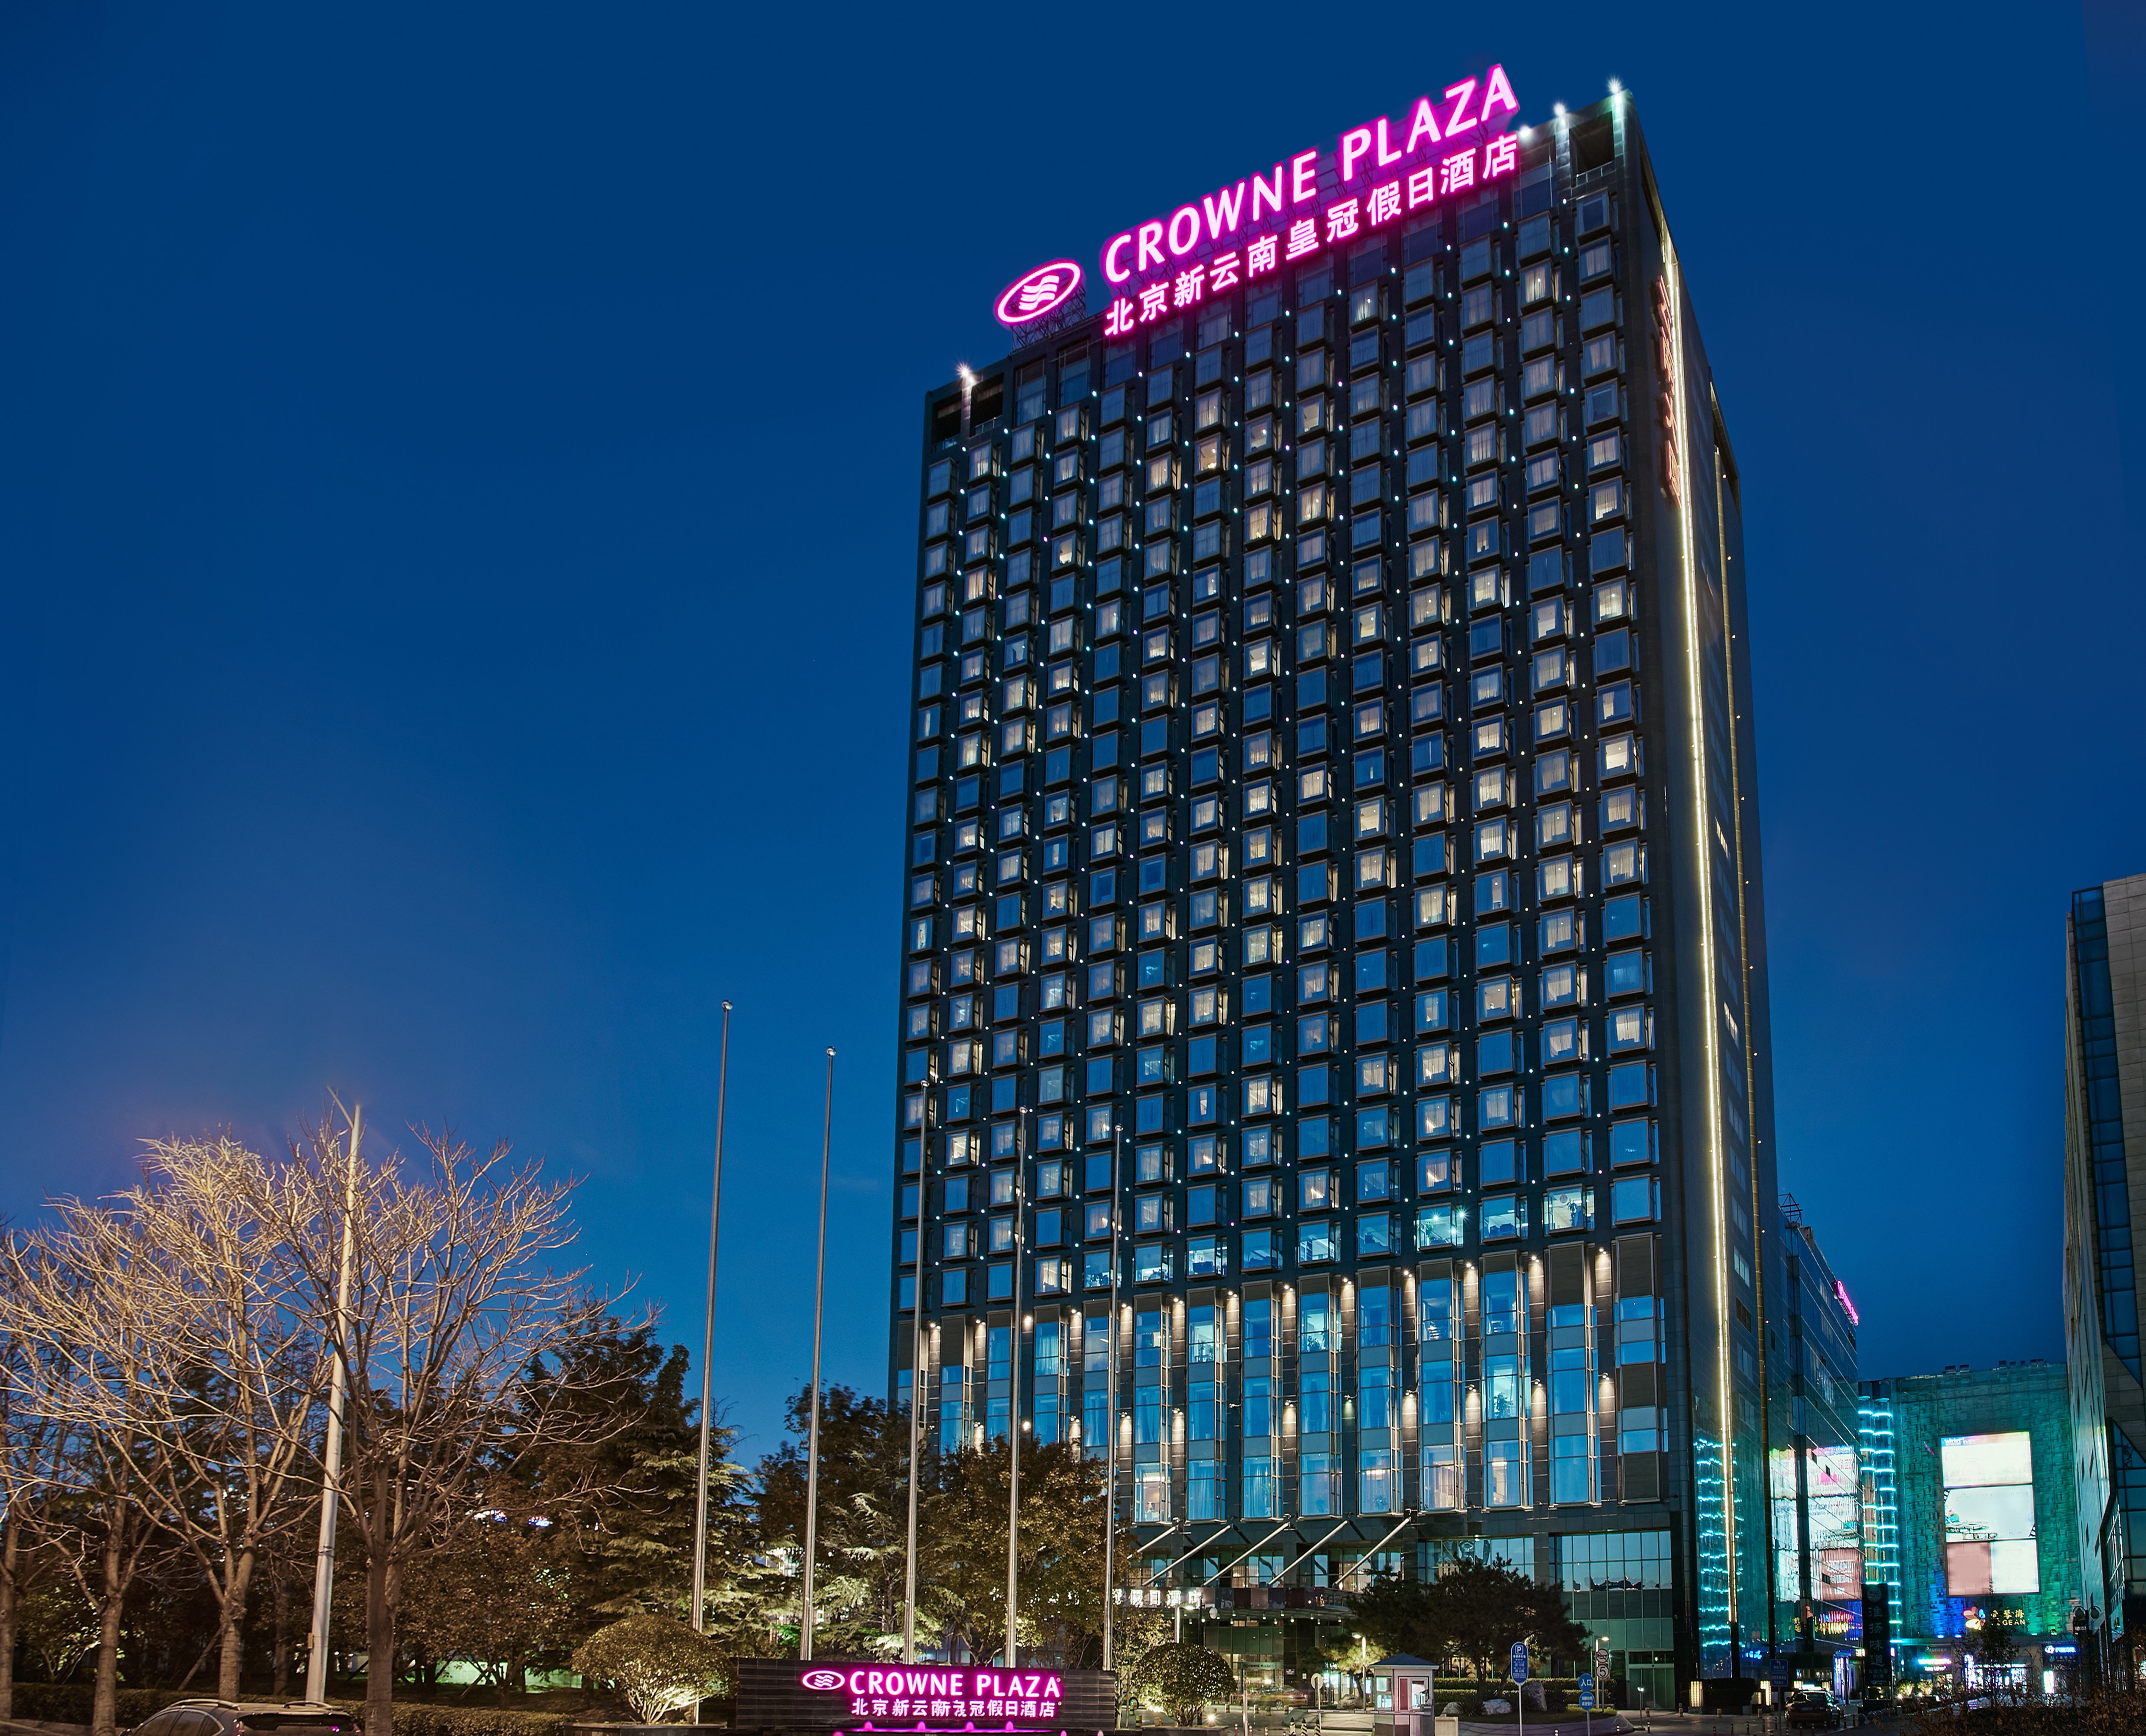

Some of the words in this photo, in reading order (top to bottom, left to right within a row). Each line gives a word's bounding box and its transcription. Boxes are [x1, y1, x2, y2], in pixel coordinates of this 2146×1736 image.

[1104, 150, 1318, 284] CROWNE
[1342, 66, 1518, 182] PLAZA
[1104, 133, 1518, 337] 北京新云南皇冠假日酒店
[1868, 1606, 1885, 1667] 淮扬味道
[849, 1670, 963, 1696] CROWNE
[976, 1674, 1060, 1698] PLAZA
[1600, 1667, 1606, 1677] 5
